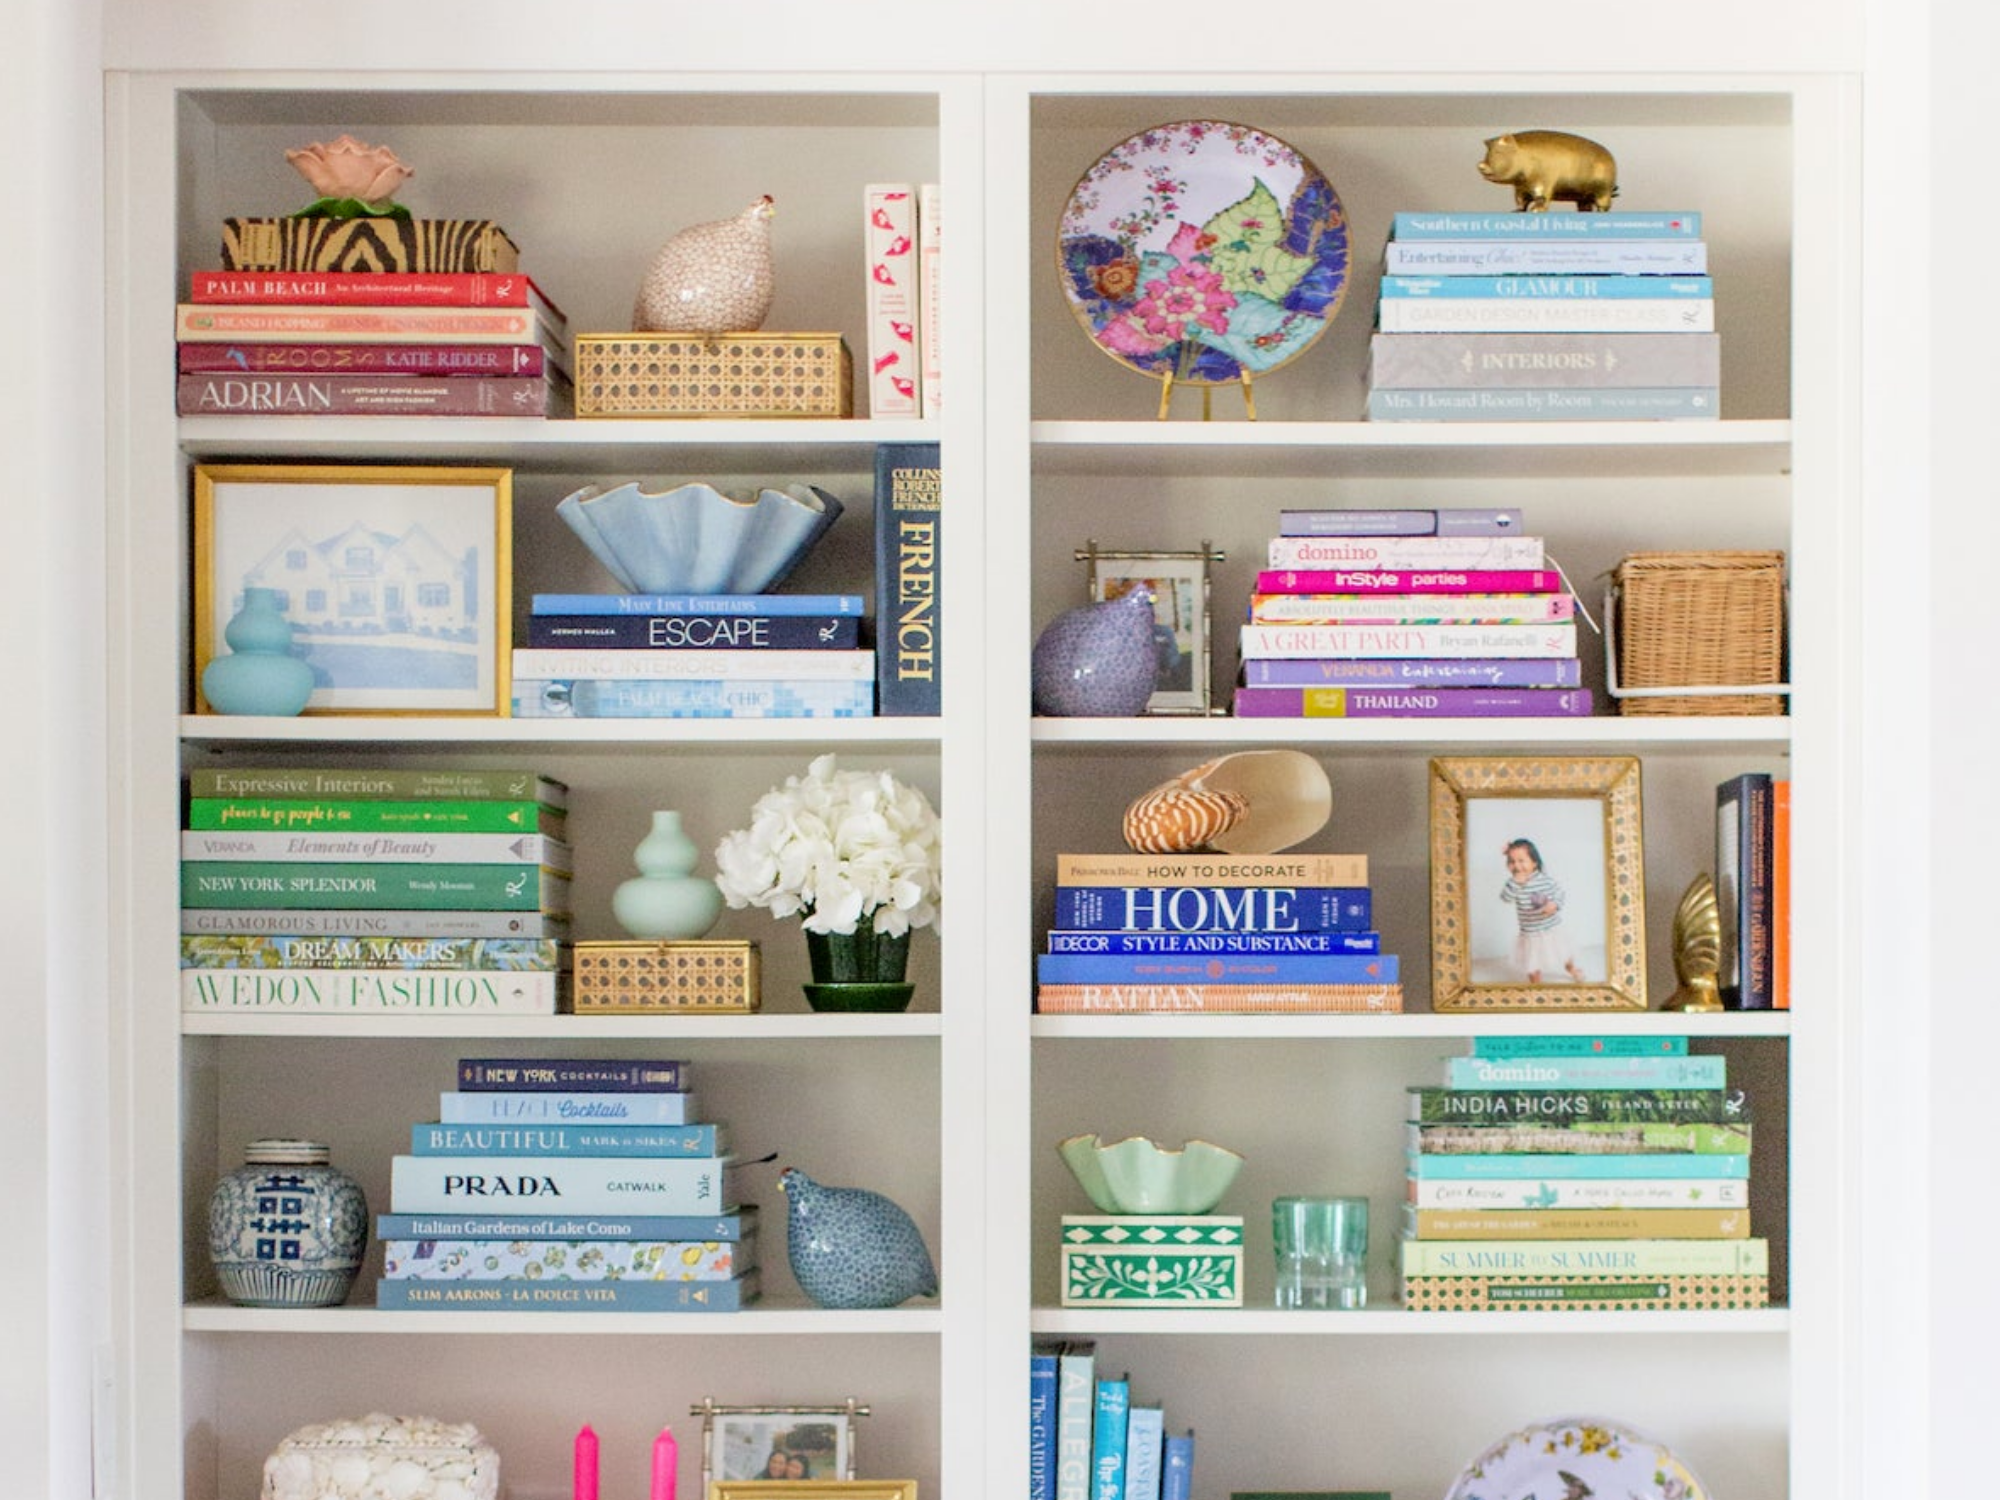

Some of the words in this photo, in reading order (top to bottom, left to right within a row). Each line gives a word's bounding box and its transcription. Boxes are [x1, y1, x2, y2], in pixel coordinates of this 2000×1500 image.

[1411, 217, 1481, 232] Southern
[1484, 217, 1540, 232] Coastal
[1543, 217, 1588, 233] Living
[1399, 249, 1483, 268] Entertaining
[207, 280, 257, 296] PALM
[264, 280, 327, 296] BEACH
[1495, 278, 1598, 296] GLAMOUR
[217, 316, 265, 330] ISLAND
[267, 316, 325, 330] HOPPING
[1410, 307, 1478, 322] GARDEN
[1481, 307, 1540, 322] DESIGN
[1545, 307, 1610, 322] MASTER
[386, 350, 433, 367] KATIE
[437, 350, 499, 367] RIDDER
[1482, 352, 1597, 370] INTERIORS
[200, 381, 331, 408] ADRIAN
[1419, 394, 1477, 408] Howard
[1481, 394, 1524, 408] Room
[1527, 394, 1542, 412] by
[1549, 394, 1592, 408] Room
[1297, 545, 1378, 561] domino
[1335, 572, 1399, 589] InStyle
[1411, 572, 1468, 587] parties
[898, 519, 935, 683] FRENCH
[1278, 603, 1347, 616] ABSOLUTELY
[1349, 603, 1406, 616] BEAUTIFUL
[1410, 603, 1456, 616] THINGS
[649, 618, 770, 646] ESCAPE
[1274, 631, 1353, 651] GREAT
[1359, 631, 1429, 651] PARTY
[1440, 634, 1478, 650] Bryan
[1481, 634, 1538, 648] Rafanelli
[525, 655, 613, 674] INVITING
[619, 655, 729, 674] INTERIORS
[1321, 663, 1395, 678] VERANDA
[726, 689, 770, 707] CHIC
[1354, 695, 1438, 710] THAILAND
[216, 774, 309, 794] Expressive
[315, 775, 395, 793] Interiors
[288, 805, 325, 827] people
[204, 840, 256, 854] VERANDA
[286, 838, 360, 855] Elements
[362, 838, 381, 858] of
[383, 839, 437, 858] Beauty
[1146, 865, 1187, 878] HOW
[1191, 865, 1213, 878] TO
[1217, 865, 1306, 878] DECORATE
[199, 877, 238, 892] NEW
[239, 877, 285, 892] YORK
[290, 877, 377, 892] SPLENDOR
[409, 880, 439, 894] Wendy
[1119, 888, 1299, 932] HOME
[197, 916, 316, 932] GLAMOROUS
[322, 916, 389, 932] LIVING
[284, 941, 362, 961] DREAM
[369, 941, 456, 961] MAKERS
[1060, 936, 1110, 952] DECOR
[1122, 936, 1179, 952] STYLE
[1184, 936, 1224, 952] AND
[1226, 936, 1331, 952] SUBSTANCE
[350, 976, 501, 1009] FASHION
[1082, 985, 1205, 1009] RATTAN
[486, 1069, 518, 1083] NEW
[523, 1068, 557, 1083] YORK
[559, 1072, 628, 1081] COCKTAILS
[1478, 1063, 1561, 1082] domino
[557, 1099, 629, 1118] Cocktails
[1444, 1096, 1507, 1115] INDIA
[1514, 1096, 1589, 1115] HICKS
[1601, 1099, 1650, 1110] ISLAND
[430, 1129, 570, 1149] BEAUTIFUL
[580, 1136, 620, 1147] MARK
[635, 1136, 677, 1147] SIKES
[443, 1175, 563, 1197] PRADA
[606, 1180, 667, 1193] CATWALK
[697, 1173, 711, 1200] Yale
[412, 1220, 463, 1235] Italian
[464, 1220, 531, 1235] Gardens
[531, 1220, 548, 1235] of
[549, 1220, 584, 1235] Lake
[586, 1221, 631, 1235] Como
[1439, 1252, 1526, 1269] SUMMER
[1551, 1252, 1638, 1269] SUMMER
[408, 1289, 443, 1303] SLIM
[444, 1289, 503, 1303] AARONS
[512, 1289, 530, 1303] LA
[533, 1289, 581, 1303] DOLCE
[584, 1289, 618, 1303] VITA
[1031, 1394, 1047, 1424] The
